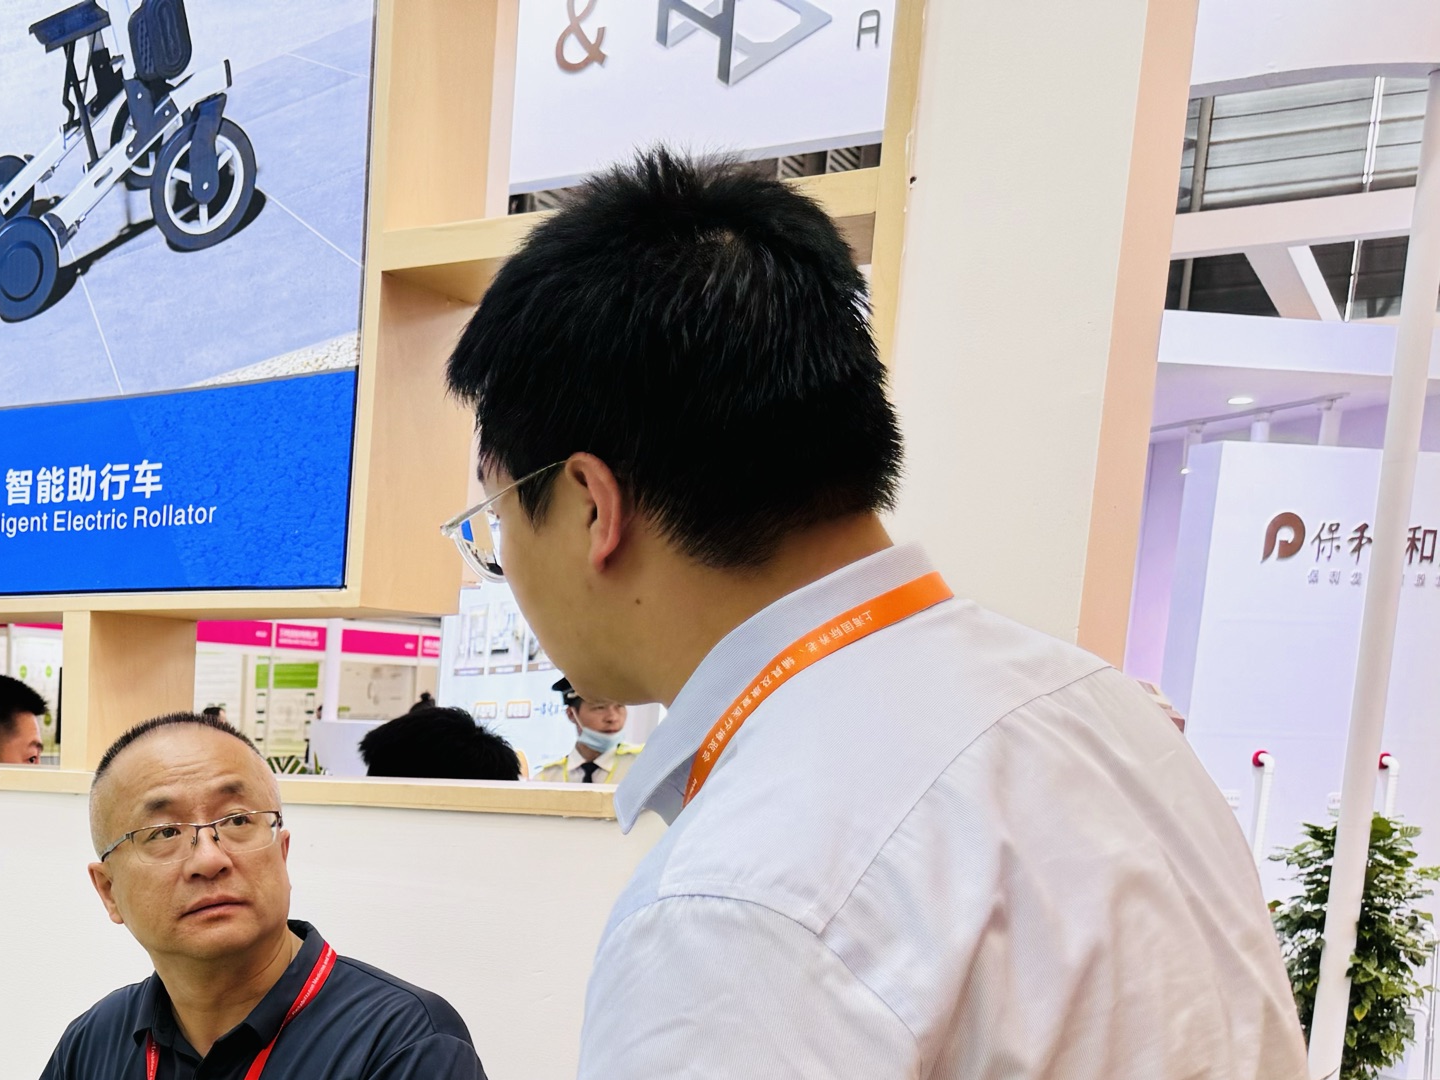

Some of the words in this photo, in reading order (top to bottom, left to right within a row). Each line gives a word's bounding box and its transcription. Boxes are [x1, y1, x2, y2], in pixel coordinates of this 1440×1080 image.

[5, 459, 163, 506] 智能助行车
[52, 508, 128, 532] Electric
[133, 504, 217, 528] Rollator
